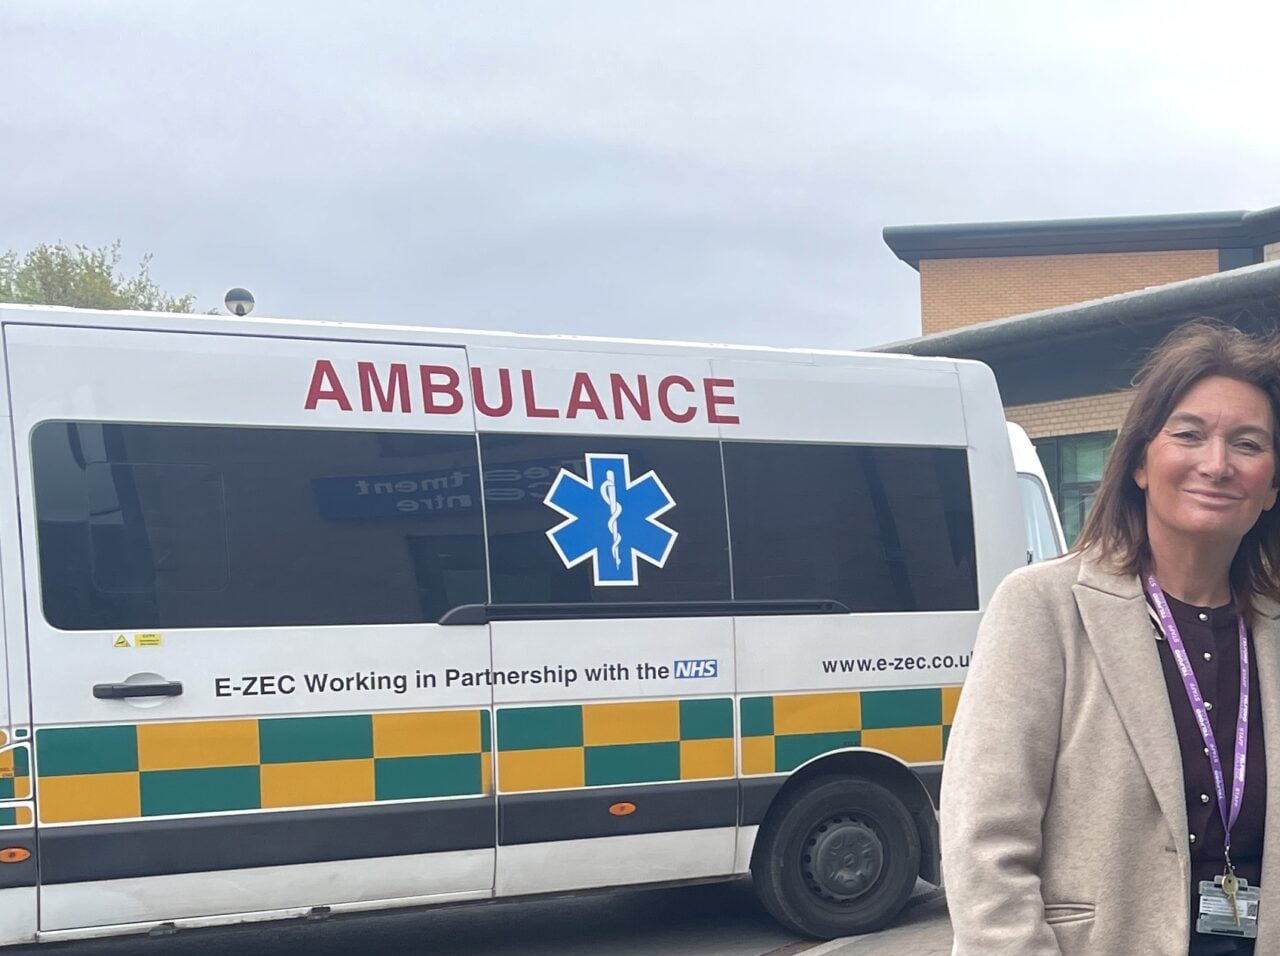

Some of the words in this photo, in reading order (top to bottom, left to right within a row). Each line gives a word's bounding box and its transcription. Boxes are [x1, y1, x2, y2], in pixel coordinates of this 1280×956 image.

[304, 359, 740, 424] AMBULANCE
[1168, 624, 1179, 643] STAFF
[214, 674, 296, 698] E-ZEC
[303, 671, 408, 694] Working
[415, 669, 437, 689] in
[445, 665, 578, 688] Partnership
[584, 663, 630, 682] with
[636, 662, 671, 680] the
[674, 659, 718, 679] NHS
